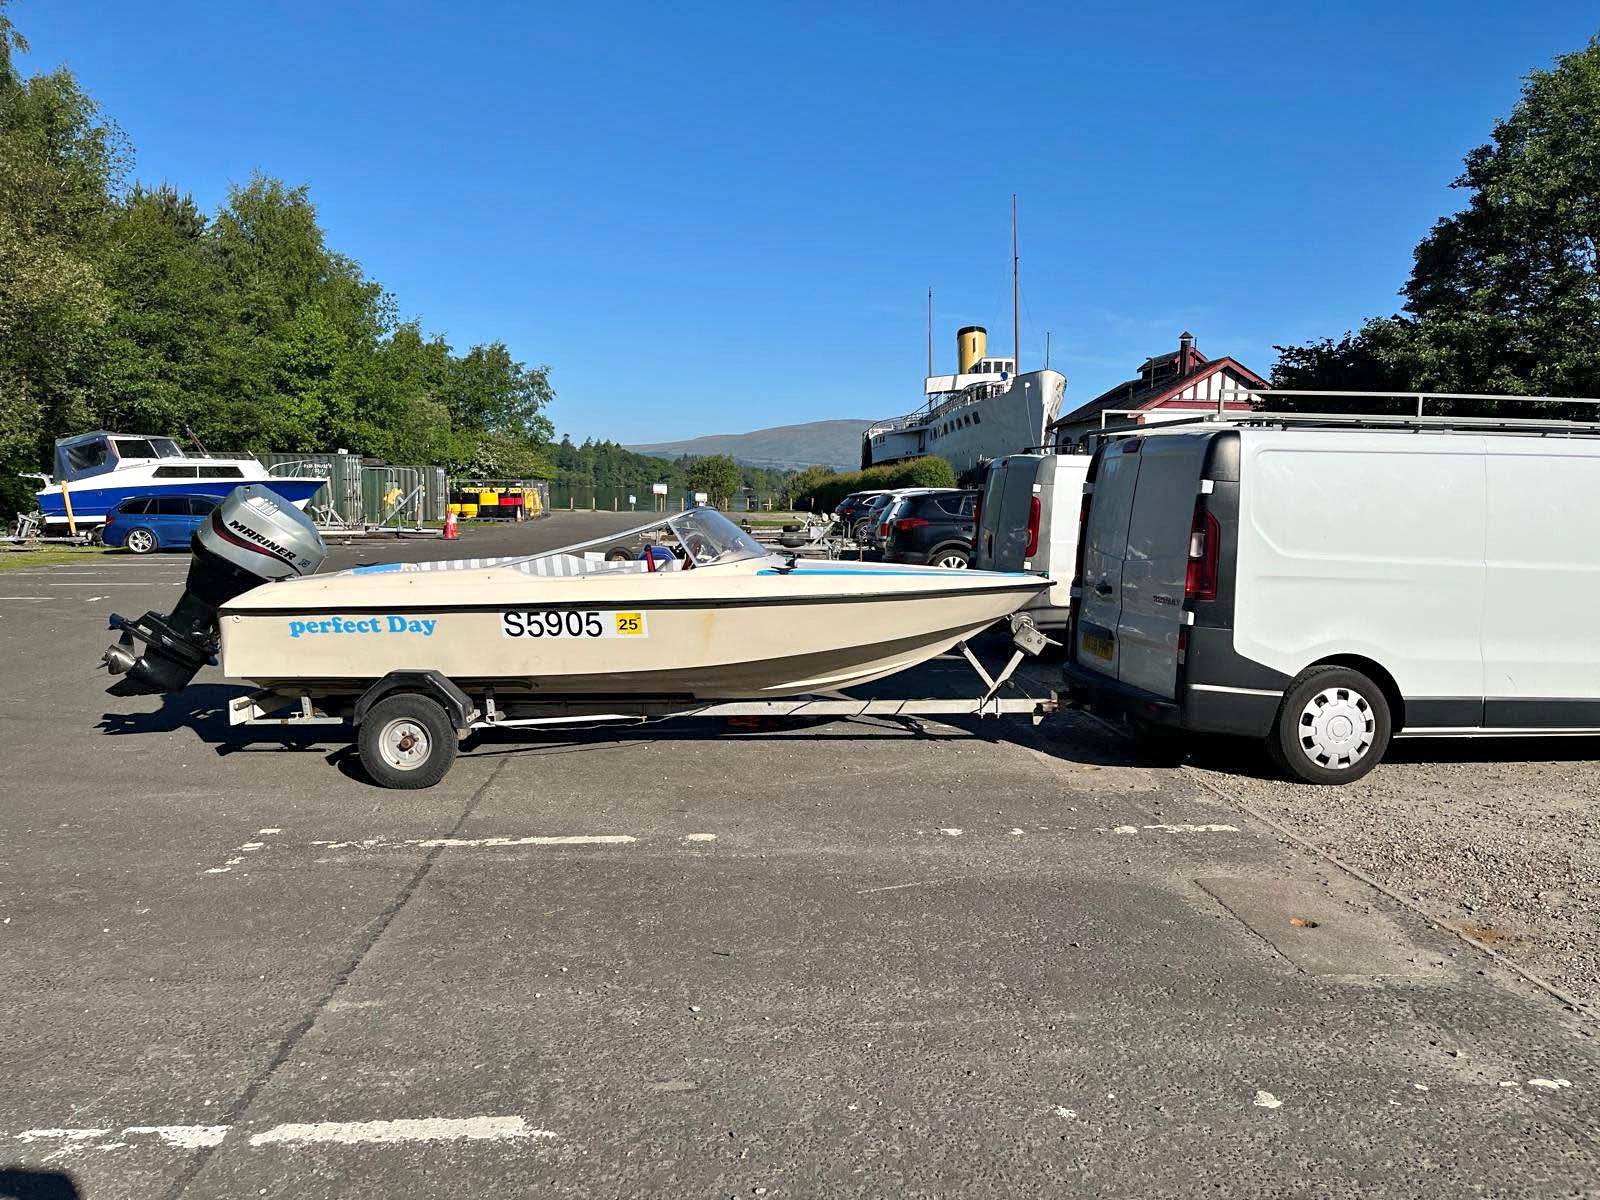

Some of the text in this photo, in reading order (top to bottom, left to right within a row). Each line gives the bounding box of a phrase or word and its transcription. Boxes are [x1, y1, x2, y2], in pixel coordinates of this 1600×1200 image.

[228, 520, 297, 560] MARINER
[288, 615, 437, 638] perfect Day
[503, 610, 603, 637] S5905
[618, 618, 639, 631] 25
